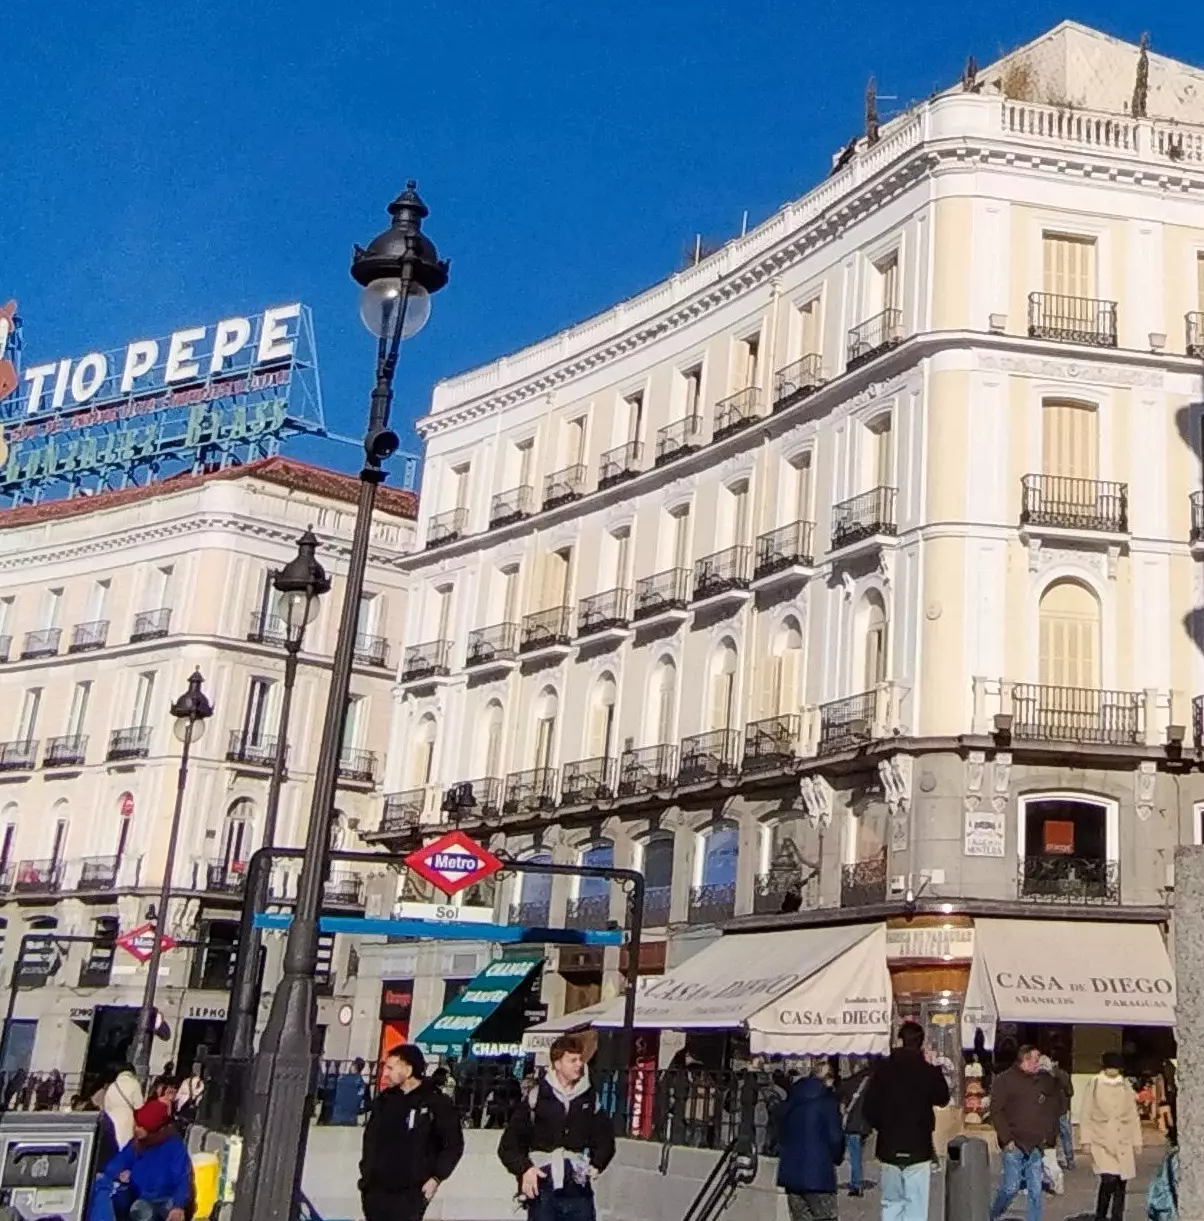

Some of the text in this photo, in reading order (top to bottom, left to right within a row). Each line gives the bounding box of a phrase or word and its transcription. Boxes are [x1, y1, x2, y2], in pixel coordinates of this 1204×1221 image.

[24, 352, 108, 414] TIO
[120, 302, 301, 393] PEPE
[434, 854, 476, 870] Metro
[435, 906, 460, 919] Sol
[996, 972, 1173, 994] CASA DE DIEGO
[779, 1010, 823, 1025] CASA
